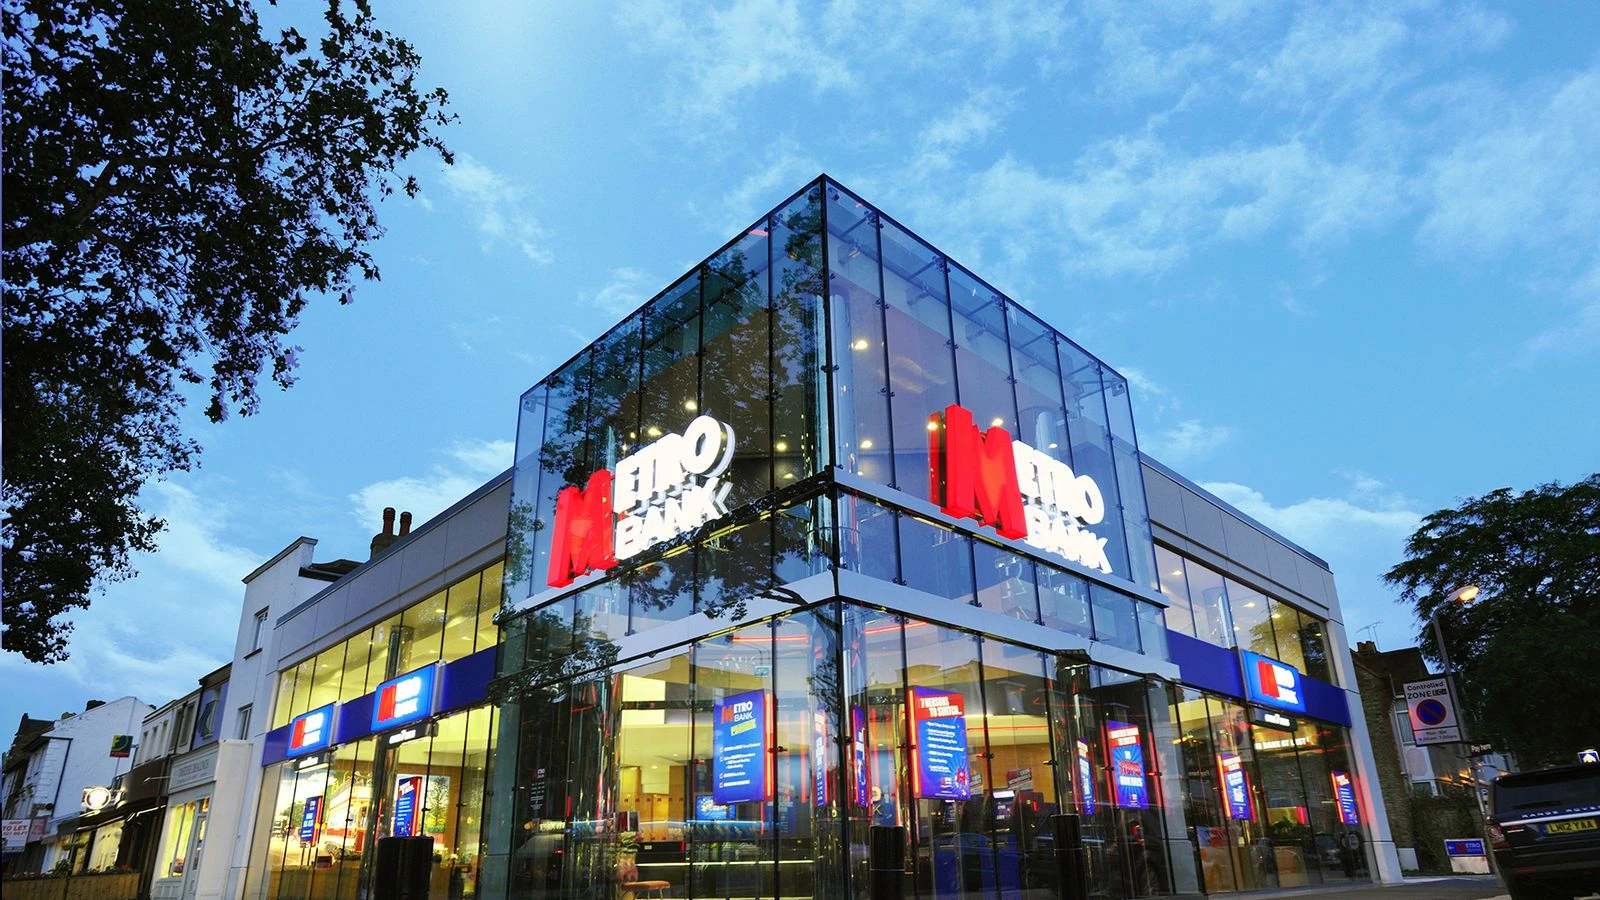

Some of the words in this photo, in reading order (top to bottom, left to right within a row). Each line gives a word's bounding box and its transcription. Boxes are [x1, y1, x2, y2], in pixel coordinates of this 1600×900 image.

[932, 403, 1105, 541] METRO
[547, 415, 736, 588] METRO
[613, 476, 728, 560] BANK
[1023, 504, 1113, 574] BANK
[1407, 681, 1444, 691] Controlled
[1407, 690, 1432, 700] ZONE
[721, 700, 754, 725] METRO
[733, 711, 753, 722] BANK
